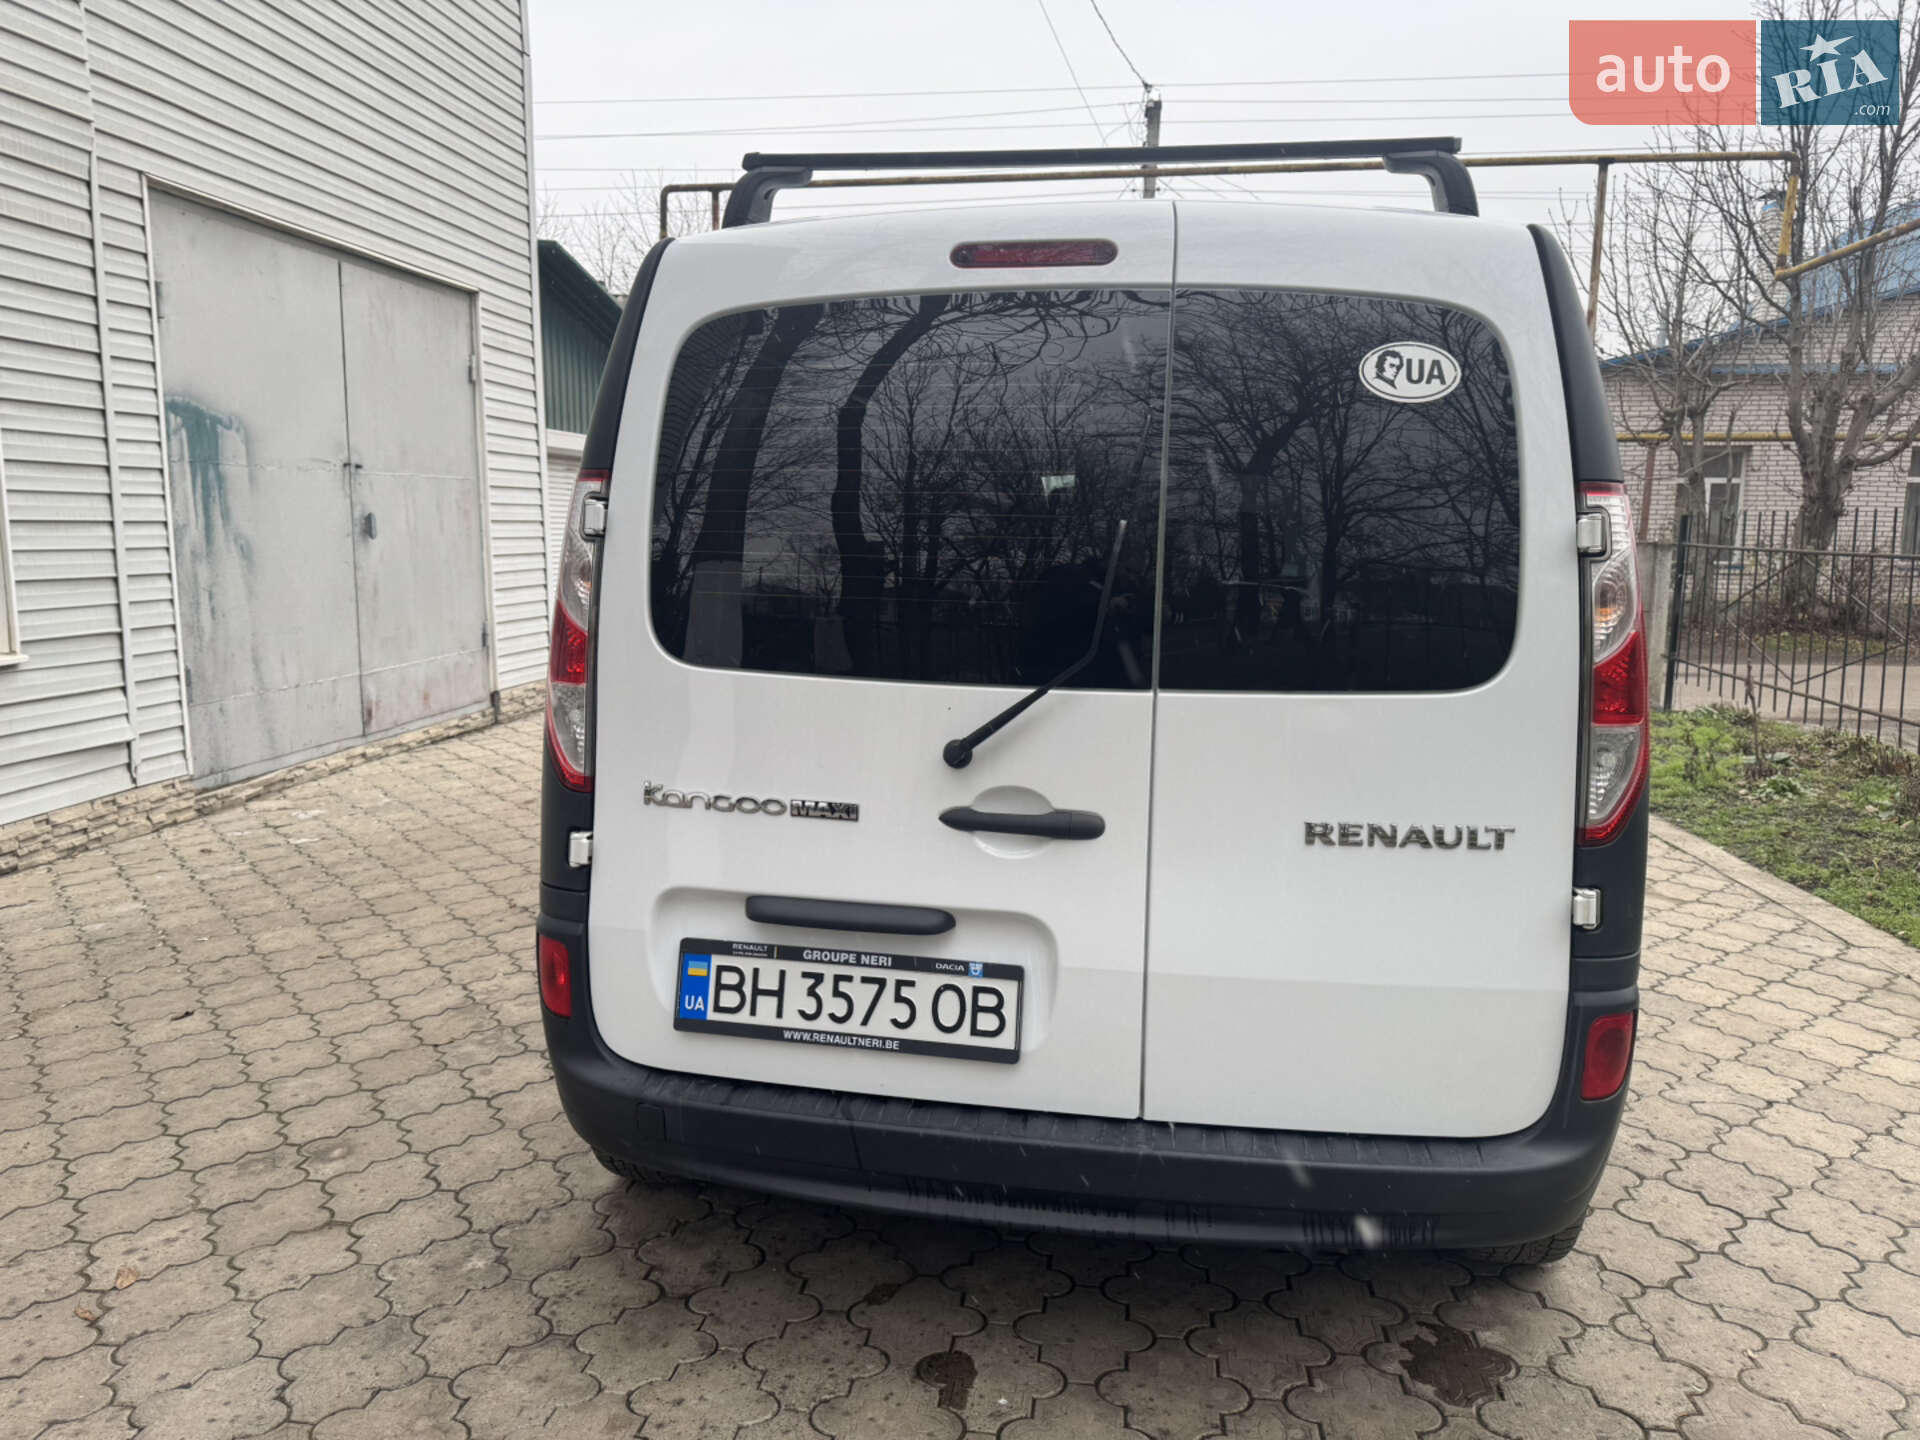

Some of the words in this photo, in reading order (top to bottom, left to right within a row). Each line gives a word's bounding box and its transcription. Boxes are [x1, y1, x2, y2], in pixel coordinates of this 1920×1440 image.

[1405, 358, 1447, 386] UA
[1304, 821, 1516, 851] RENAULT
[732, 943, 768, 953] RENAULT
[803, 949, 857, 964] GROUPE
[861, 952, 892, 967] NERI
[935, 961, 965, 972] DACIA
[684, 994, 705, 1012] UA
[713, 965, 786, 1019] BH
[798, 971, 917, 1030] 3575
[783, 1030, 900, 1050] WWW.RENAULTNERI.BE
